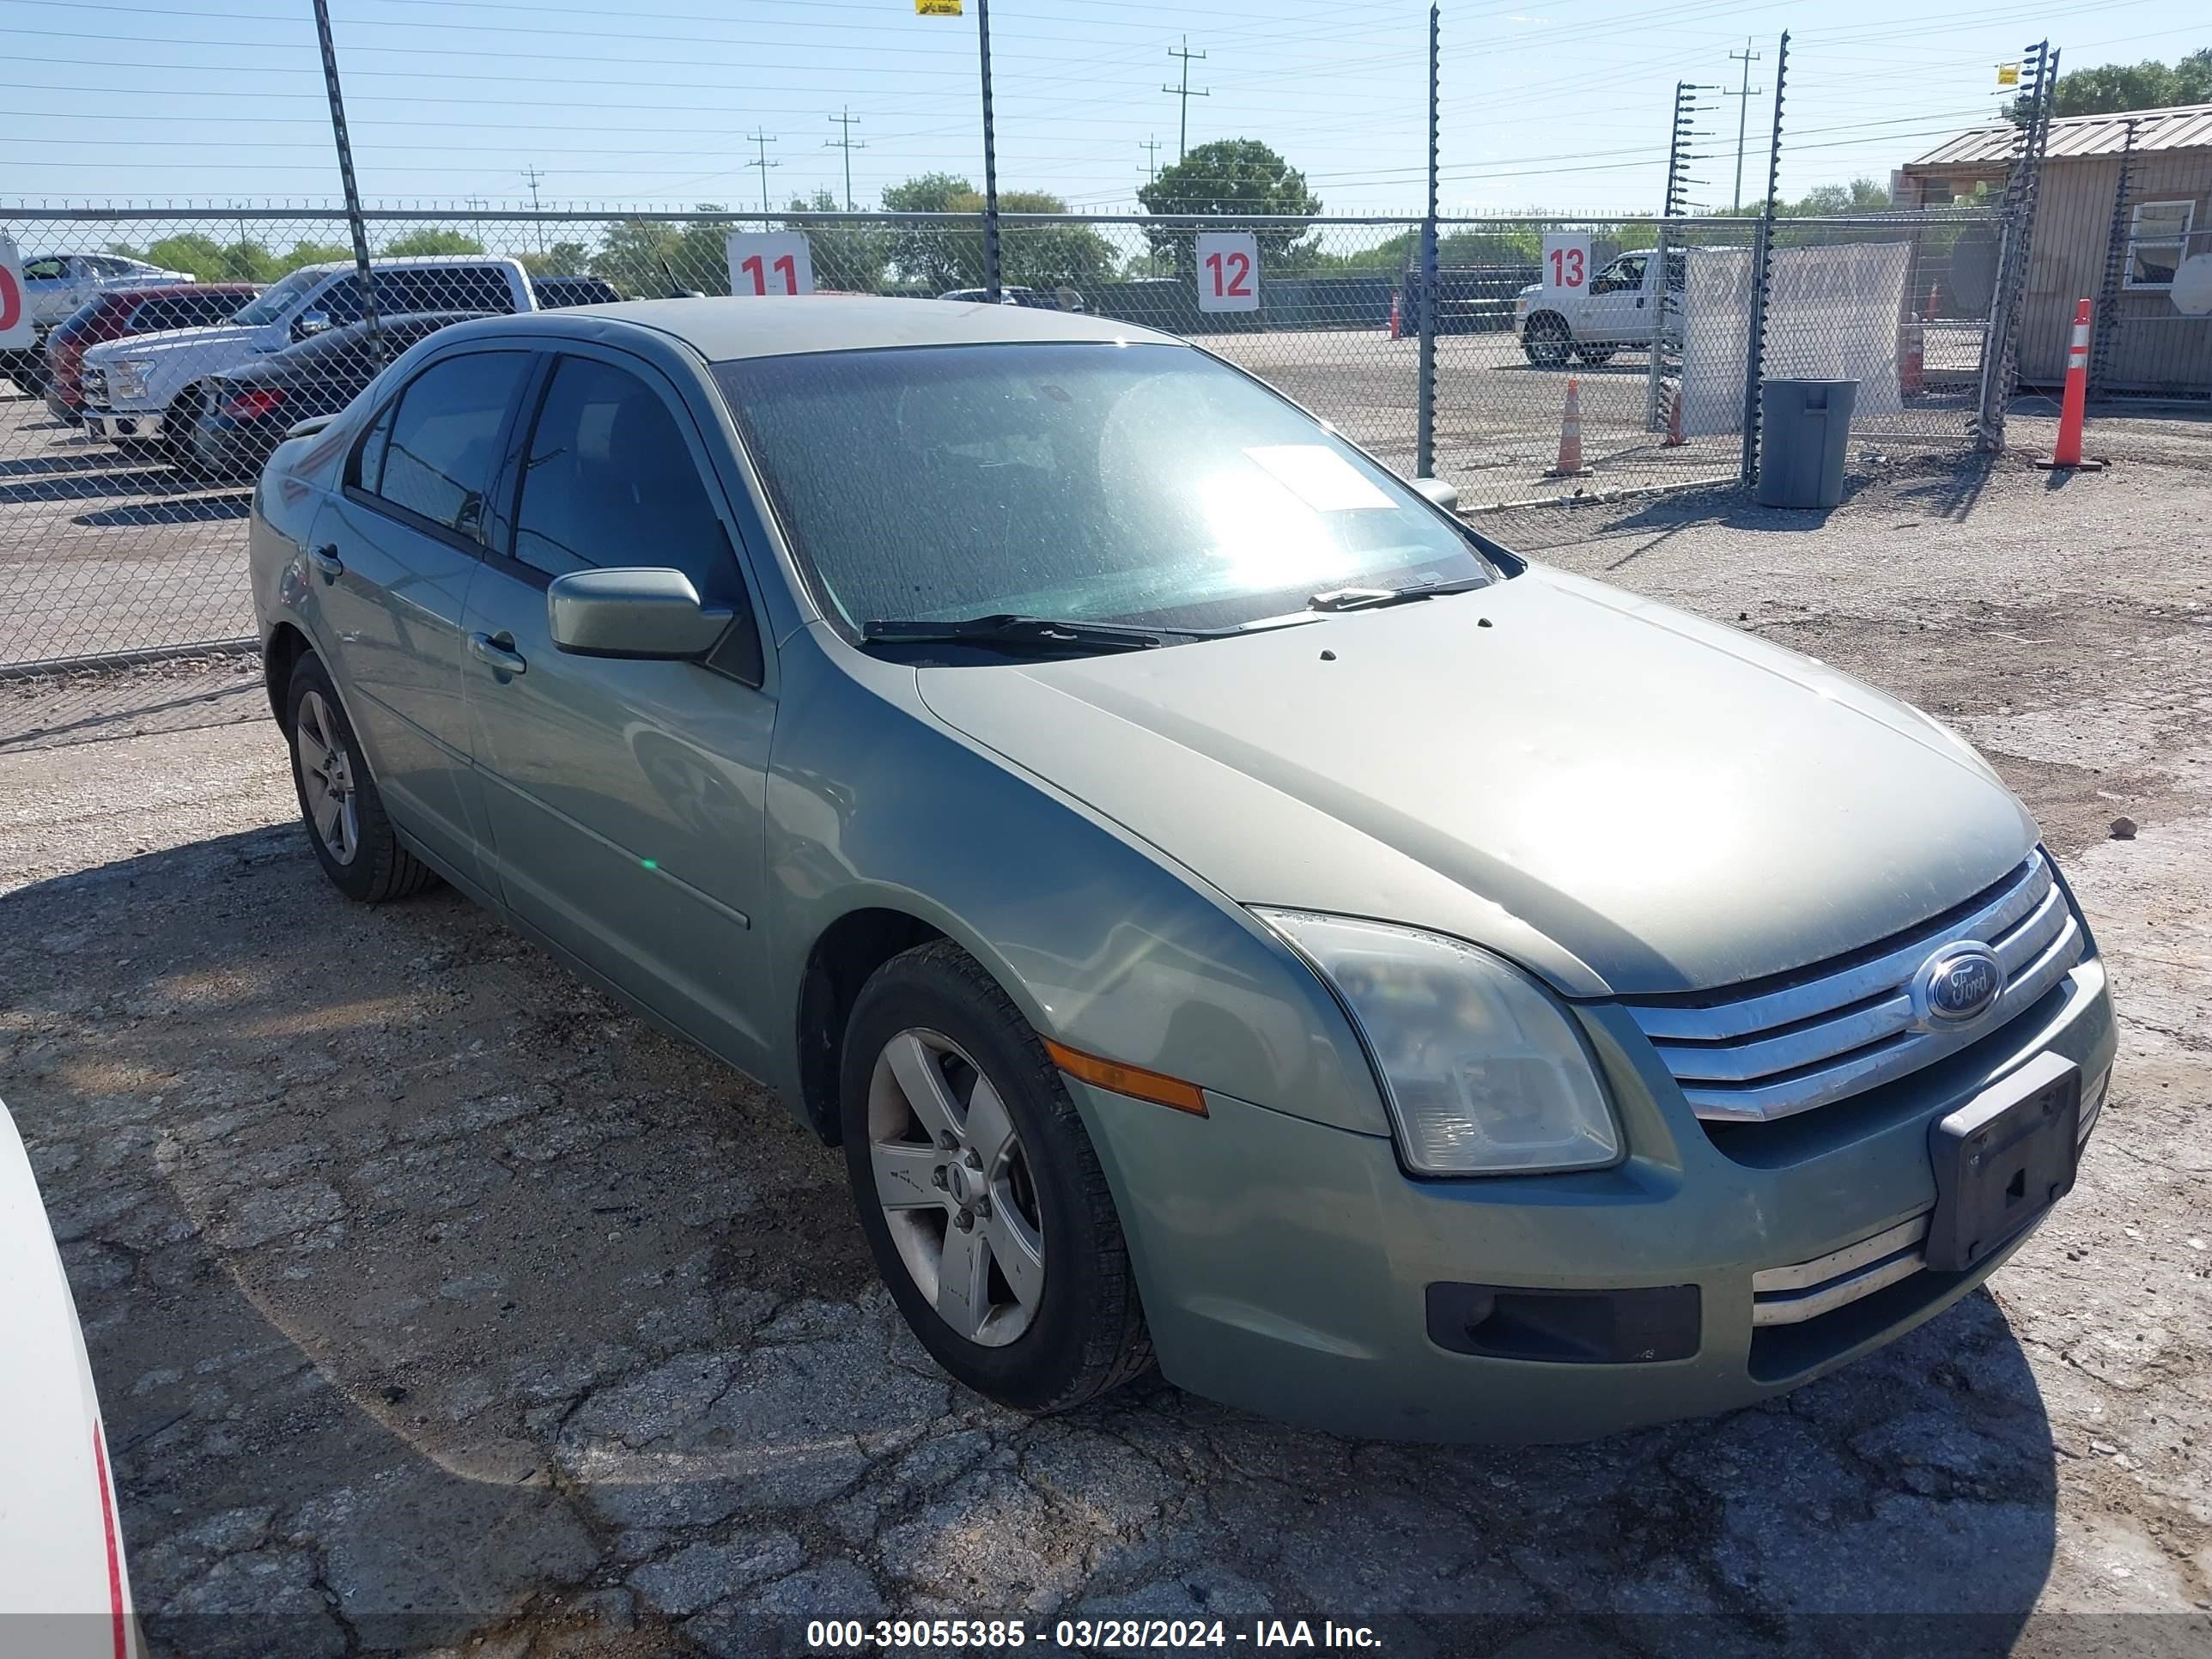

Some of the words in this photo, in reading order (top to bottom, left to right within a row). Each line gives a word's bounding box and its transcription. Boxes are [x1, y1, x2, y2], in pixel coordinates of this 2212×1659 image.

[741, 255, 798, 295] 11
[1206, 252, 1252, 297] 12
[1550, 248, 1584, 288] 13
[1950, 964, 1990, 1006] Ford
